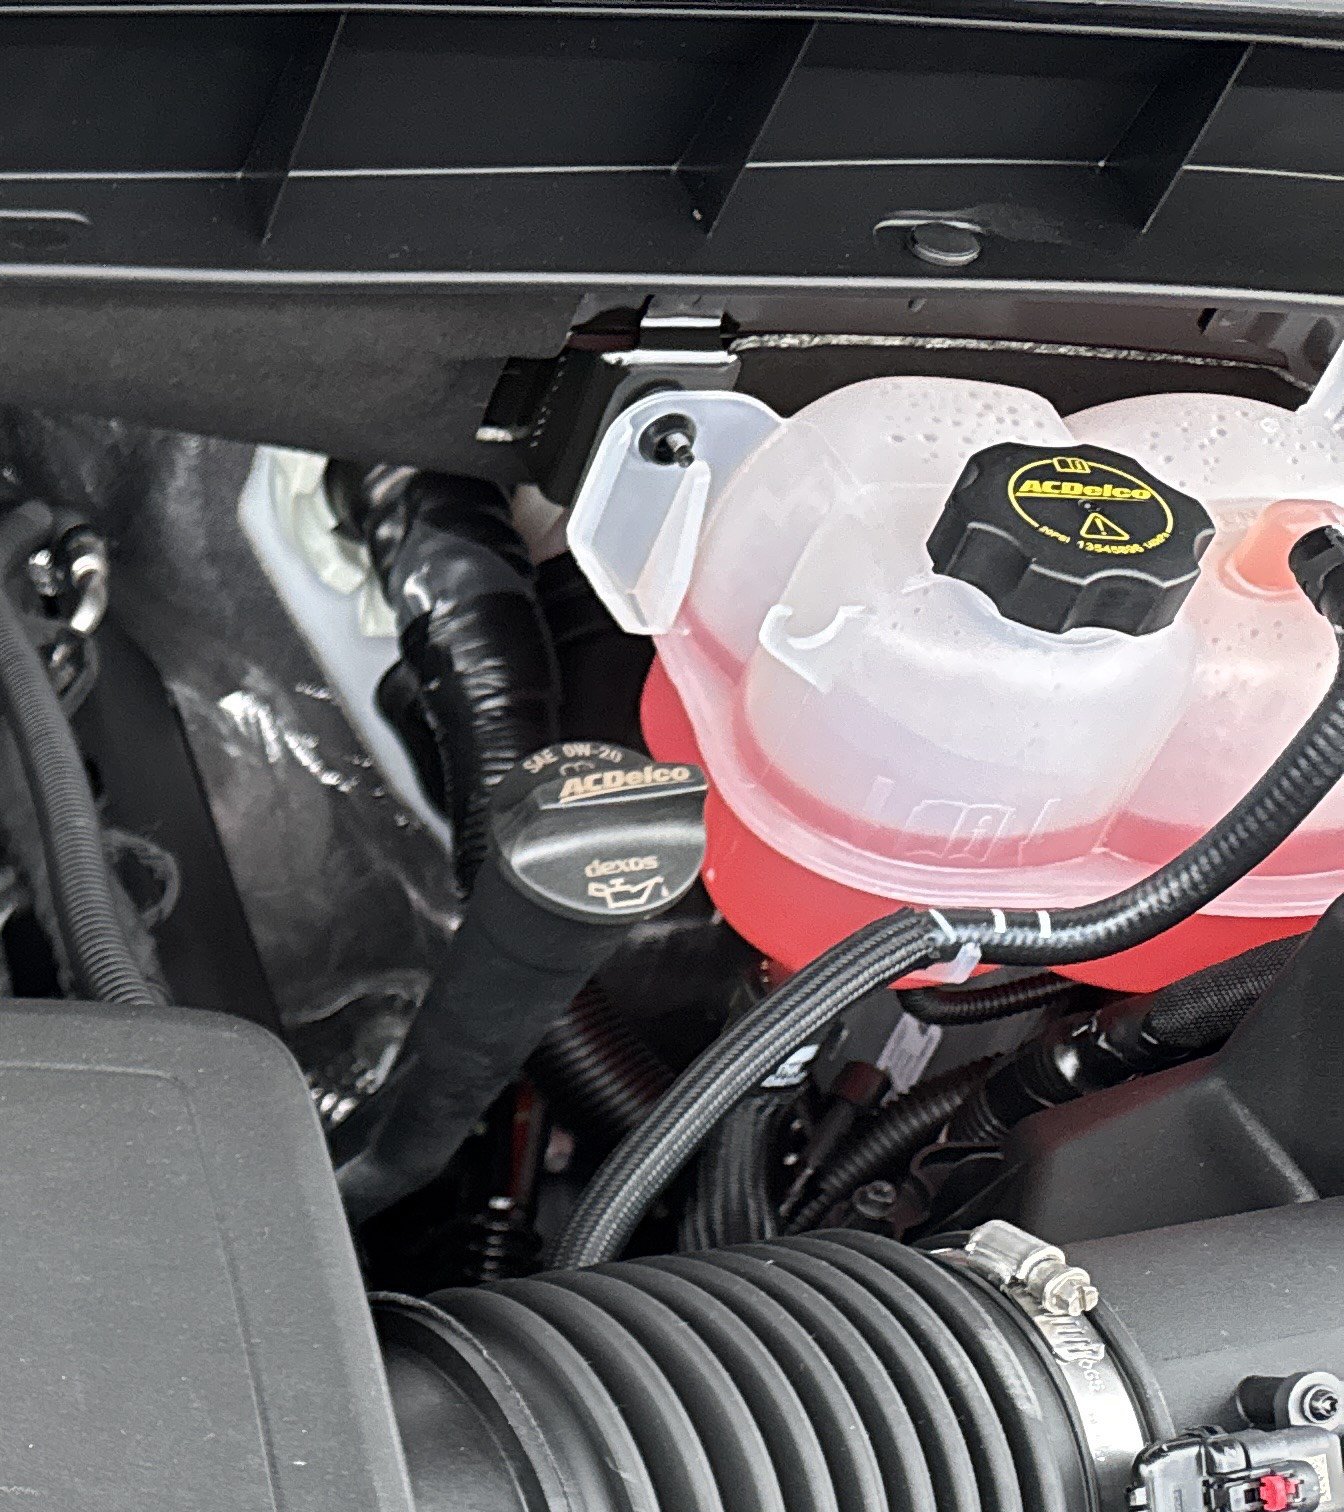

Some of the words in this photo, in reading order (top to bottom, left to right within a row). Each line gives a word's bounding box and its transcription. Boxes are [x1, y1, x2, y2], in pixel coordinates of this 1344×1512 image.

[1018, 479, 1152, 499] ACDelco
[522, 748, 559, 774] SAE
[562, 742, 624, 763] 0W-20
[558, 765, 691, 799] ACDelco
[584, 856, 659, 878] dexos
